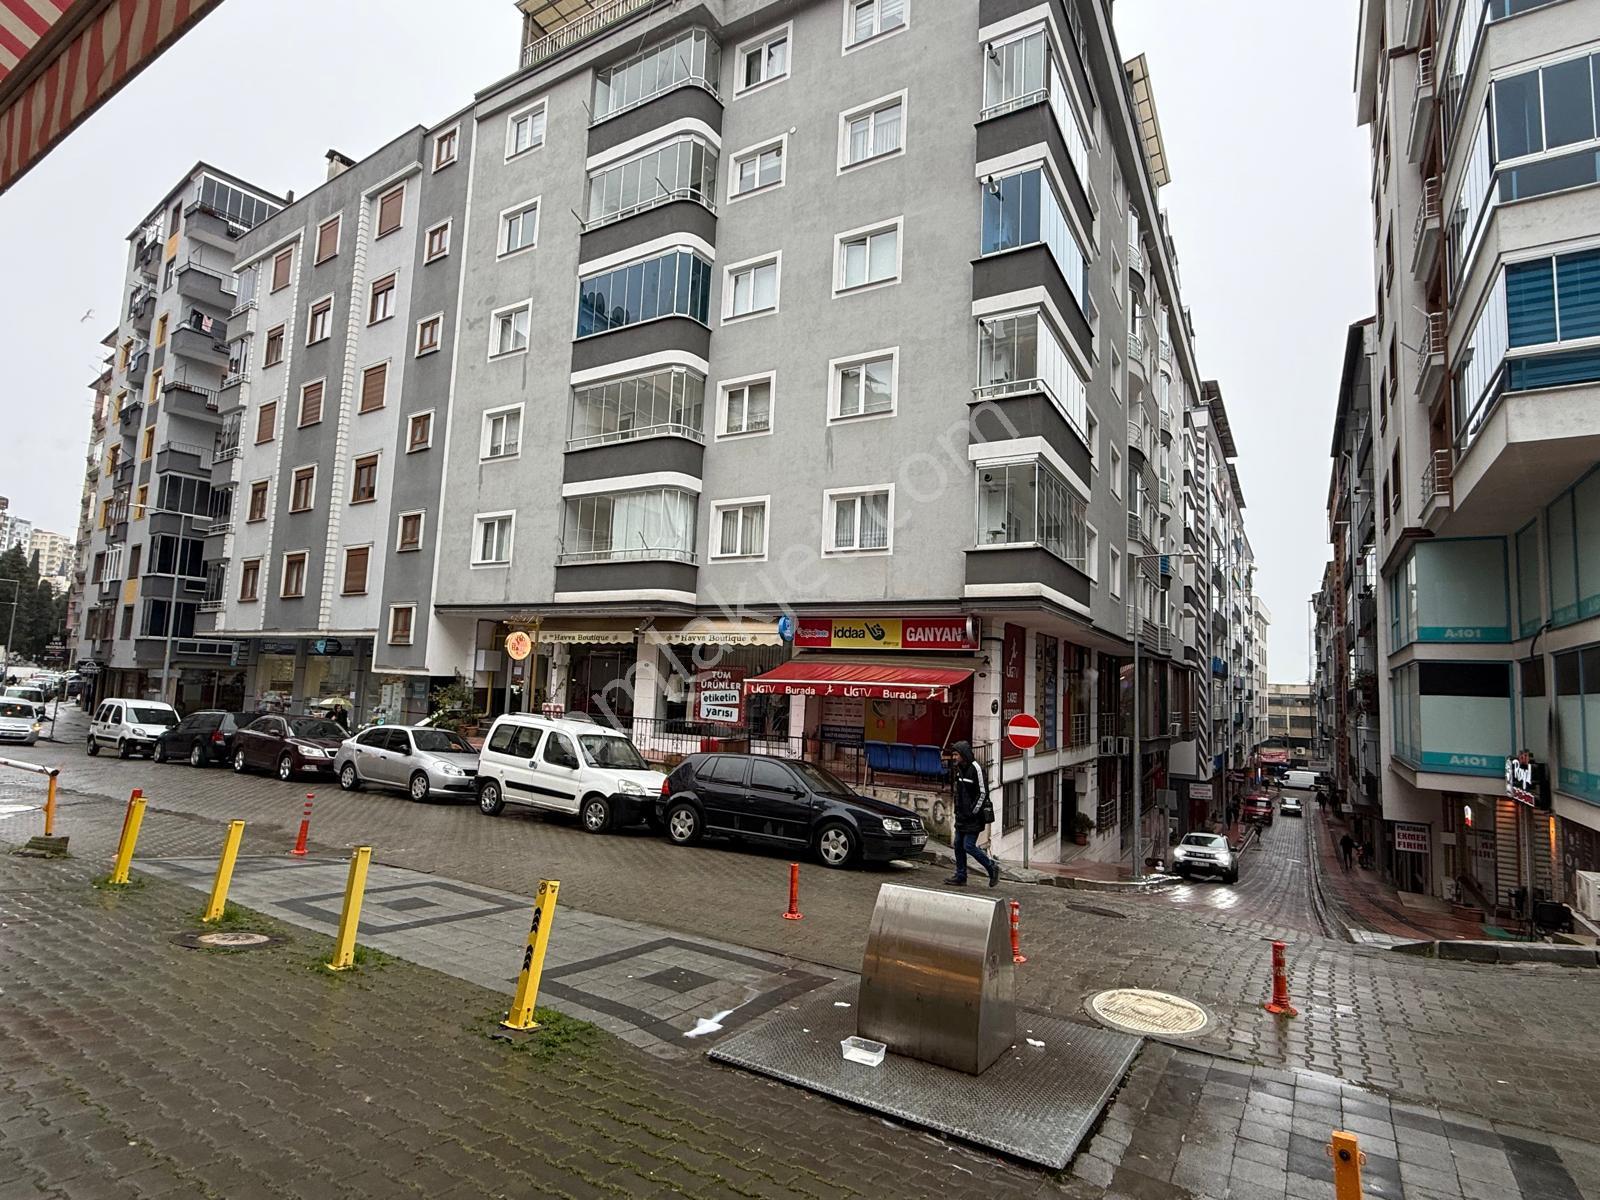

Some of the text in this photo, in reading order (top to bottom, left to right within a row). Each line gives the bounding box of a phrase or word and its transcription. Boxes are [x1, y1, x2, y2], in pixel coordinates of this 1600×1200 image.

[577, 634, 609, 642] Boutique
[833, 626, 865, 639] iddaa
[906, 627, 962, 642] GANYAN
[709, 634, 747, 643] Boutique
[703, 692, 737, 702] etiketin
[785, 686, 816, 695] Burada
[882, 689, 918, 700] Burada
[705, 707, 733, 718] yarısı
